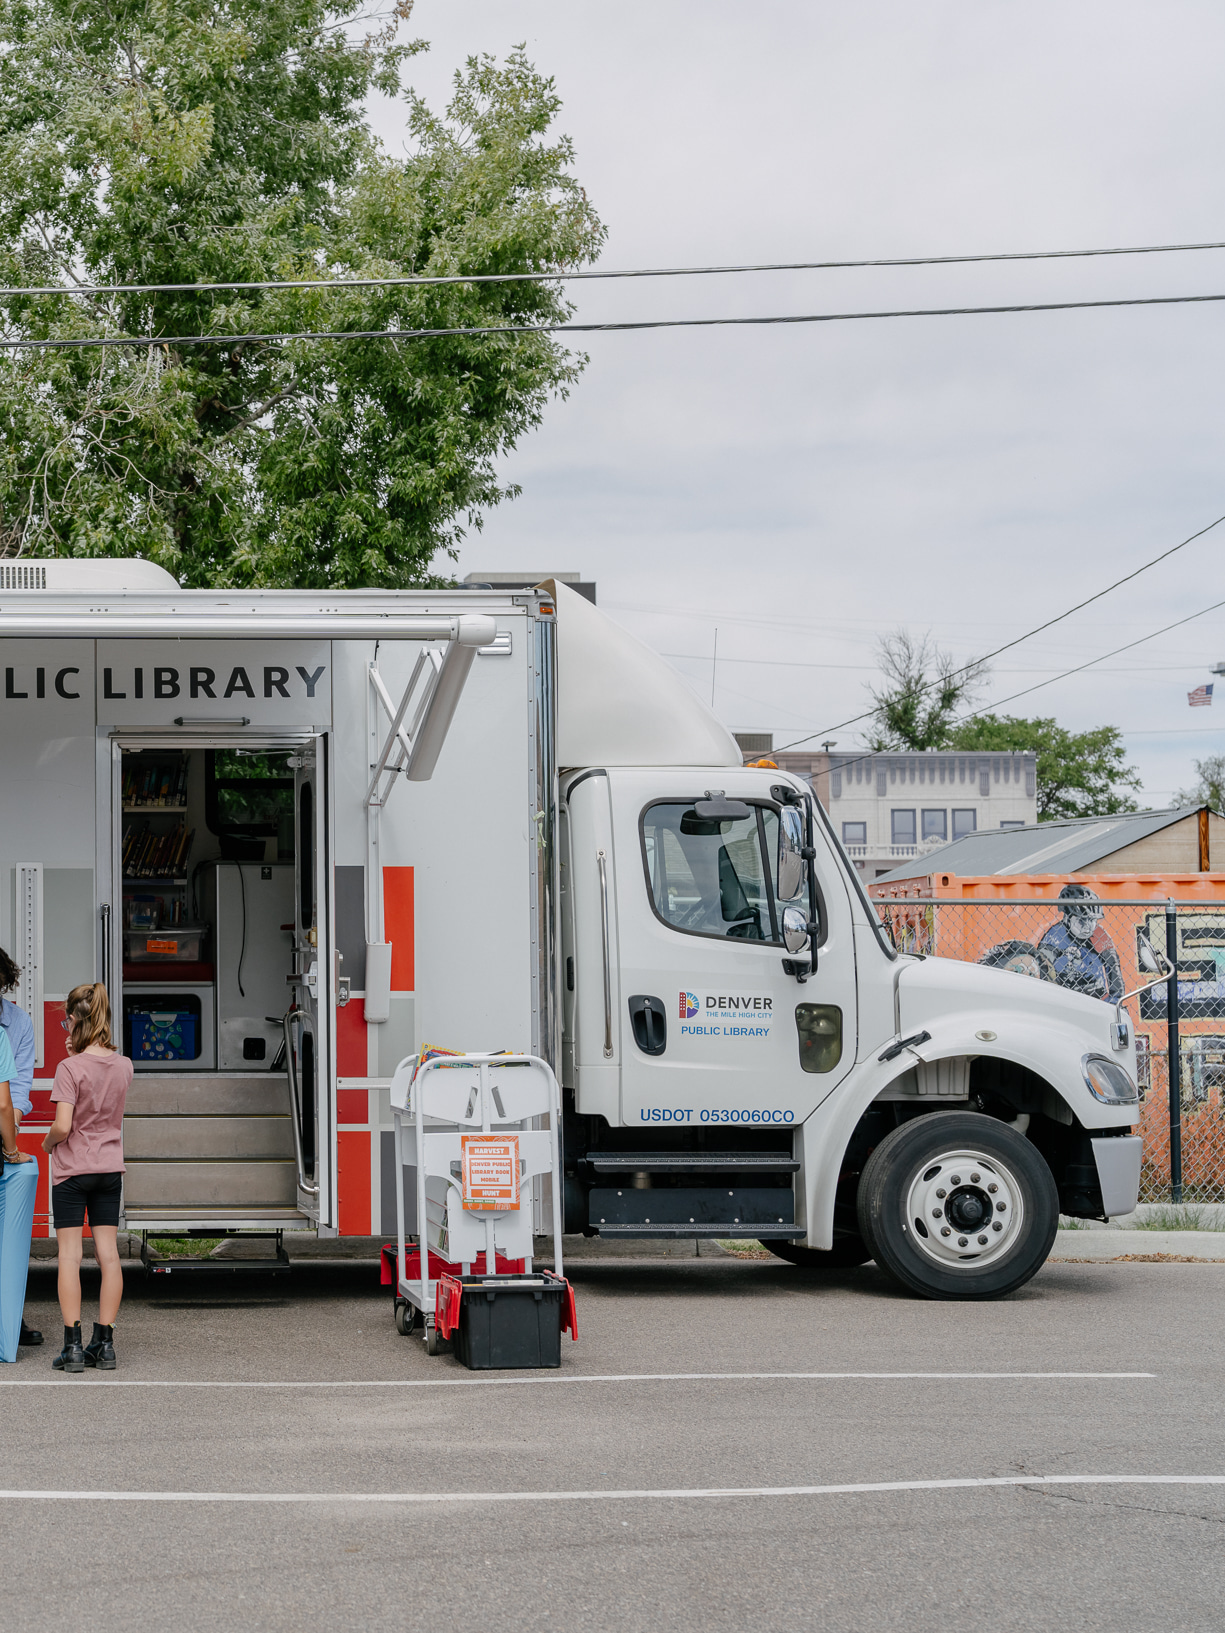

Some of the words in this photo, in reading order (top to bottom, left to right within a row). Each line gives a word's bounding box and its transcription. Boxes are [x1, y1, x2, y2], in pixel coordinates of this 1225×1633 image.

[103, 666, 327, 700] LIBRARY
[705, 996, 773, 1010] DENVER
[681, 1025, 721, 1035] PUBLIC
[723, 1027, 770, 1037] LIBRARY
[640, 1108, 694, 1122] USDOT
[699, 1109, 795, 1123] 0530060CO
